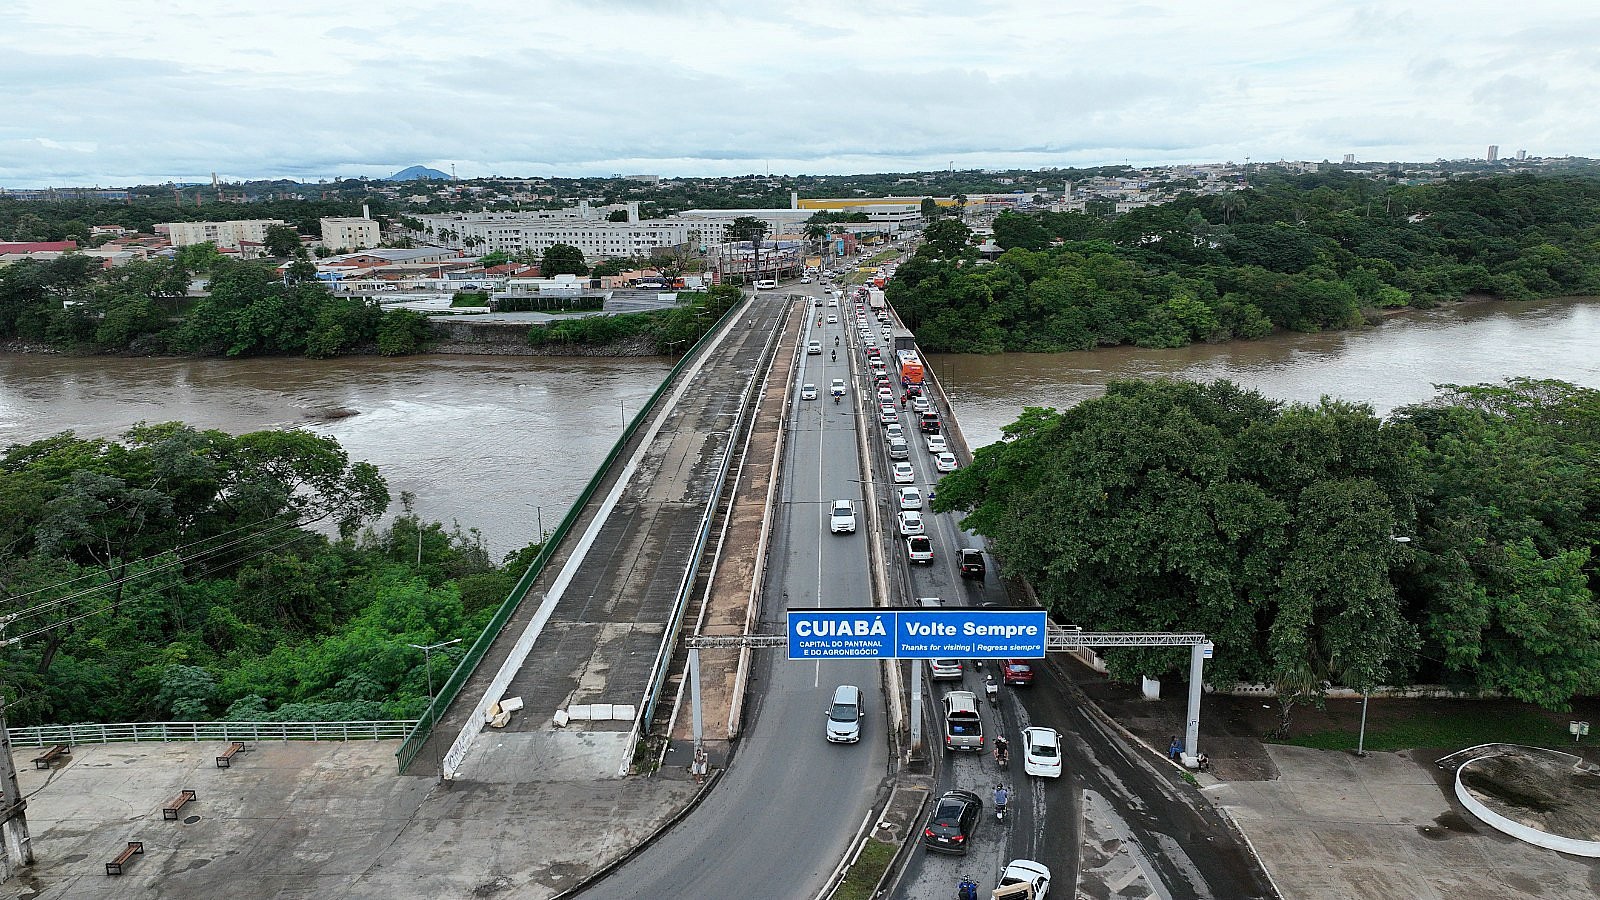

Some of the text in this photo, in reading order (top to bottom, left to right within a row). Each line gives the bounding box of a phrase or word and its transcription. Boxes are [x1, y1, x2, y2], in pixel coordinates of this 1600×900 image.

[795, 615, 887, 637] CUIABÁ
[905, 621, 1038, 639] Volte Sempre
[844, 640, 883, 648] PANTANAL
[901, 643, 1041, 652] Thanks for visiting Regresa siempre
[823, 647, 879, 656] AGRONEGÓCIO
